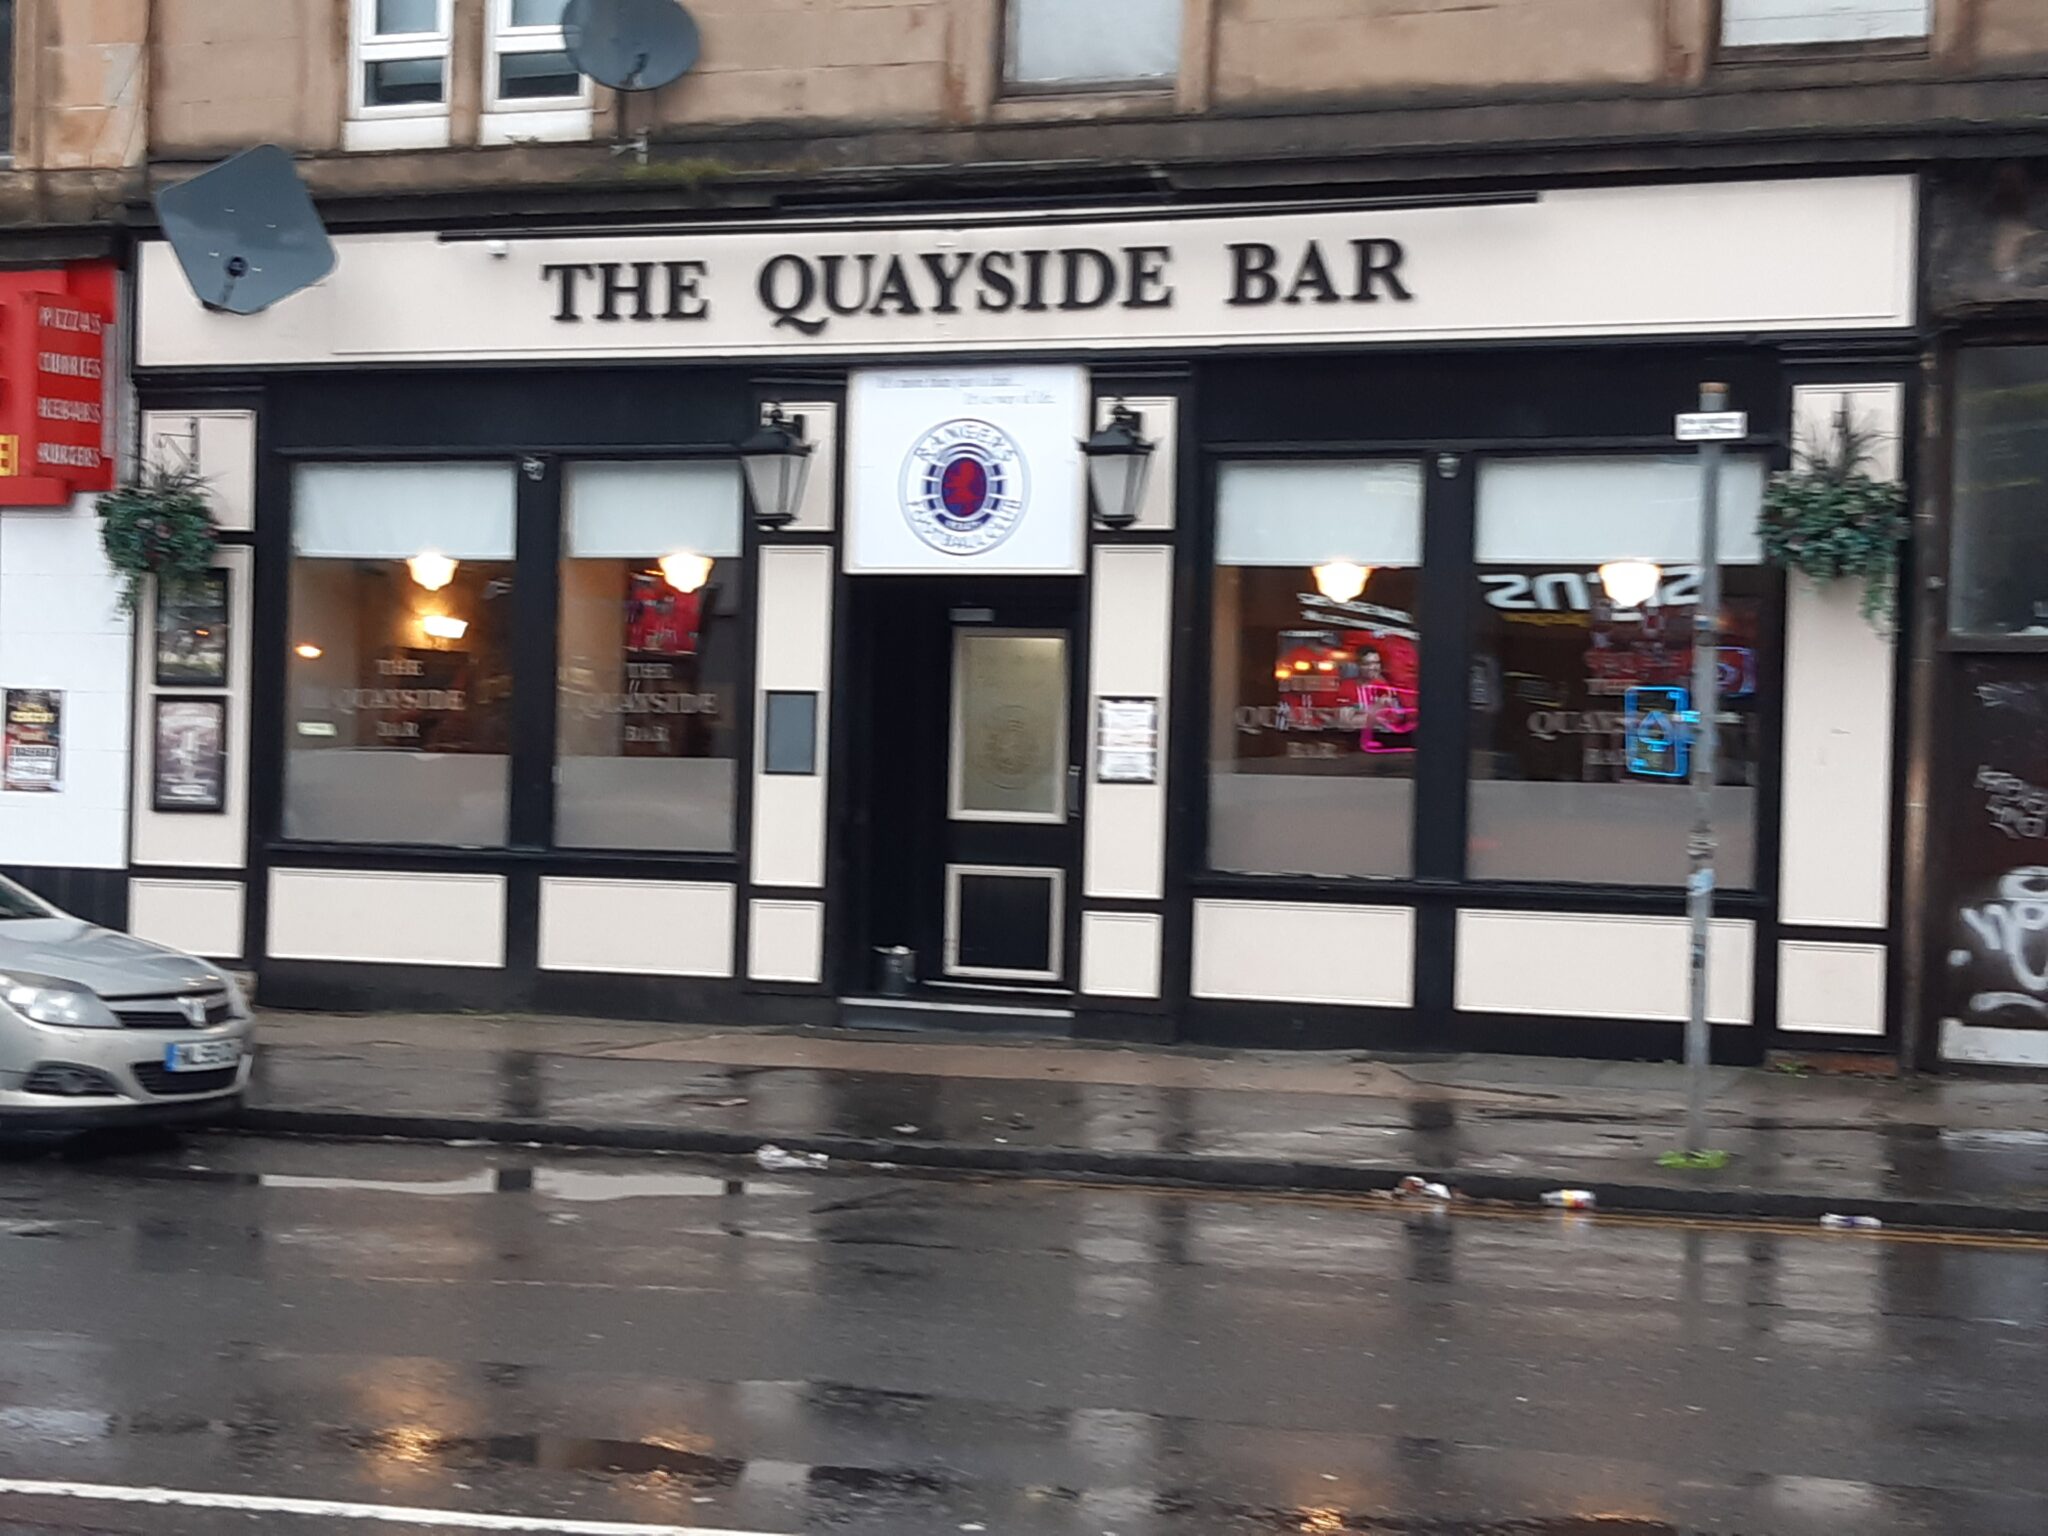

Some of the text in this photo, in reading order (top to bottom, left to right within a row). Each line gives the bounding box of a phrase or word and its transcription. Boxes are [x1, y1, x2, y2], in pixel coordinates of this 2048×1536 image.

[541, 238, 1414, 335] THE QUAYSIDE BAR
[40, 306, 101, 335] PIZZAS
[376, 658, 424, 676] THE
[626, 662, 673, 679] THE
